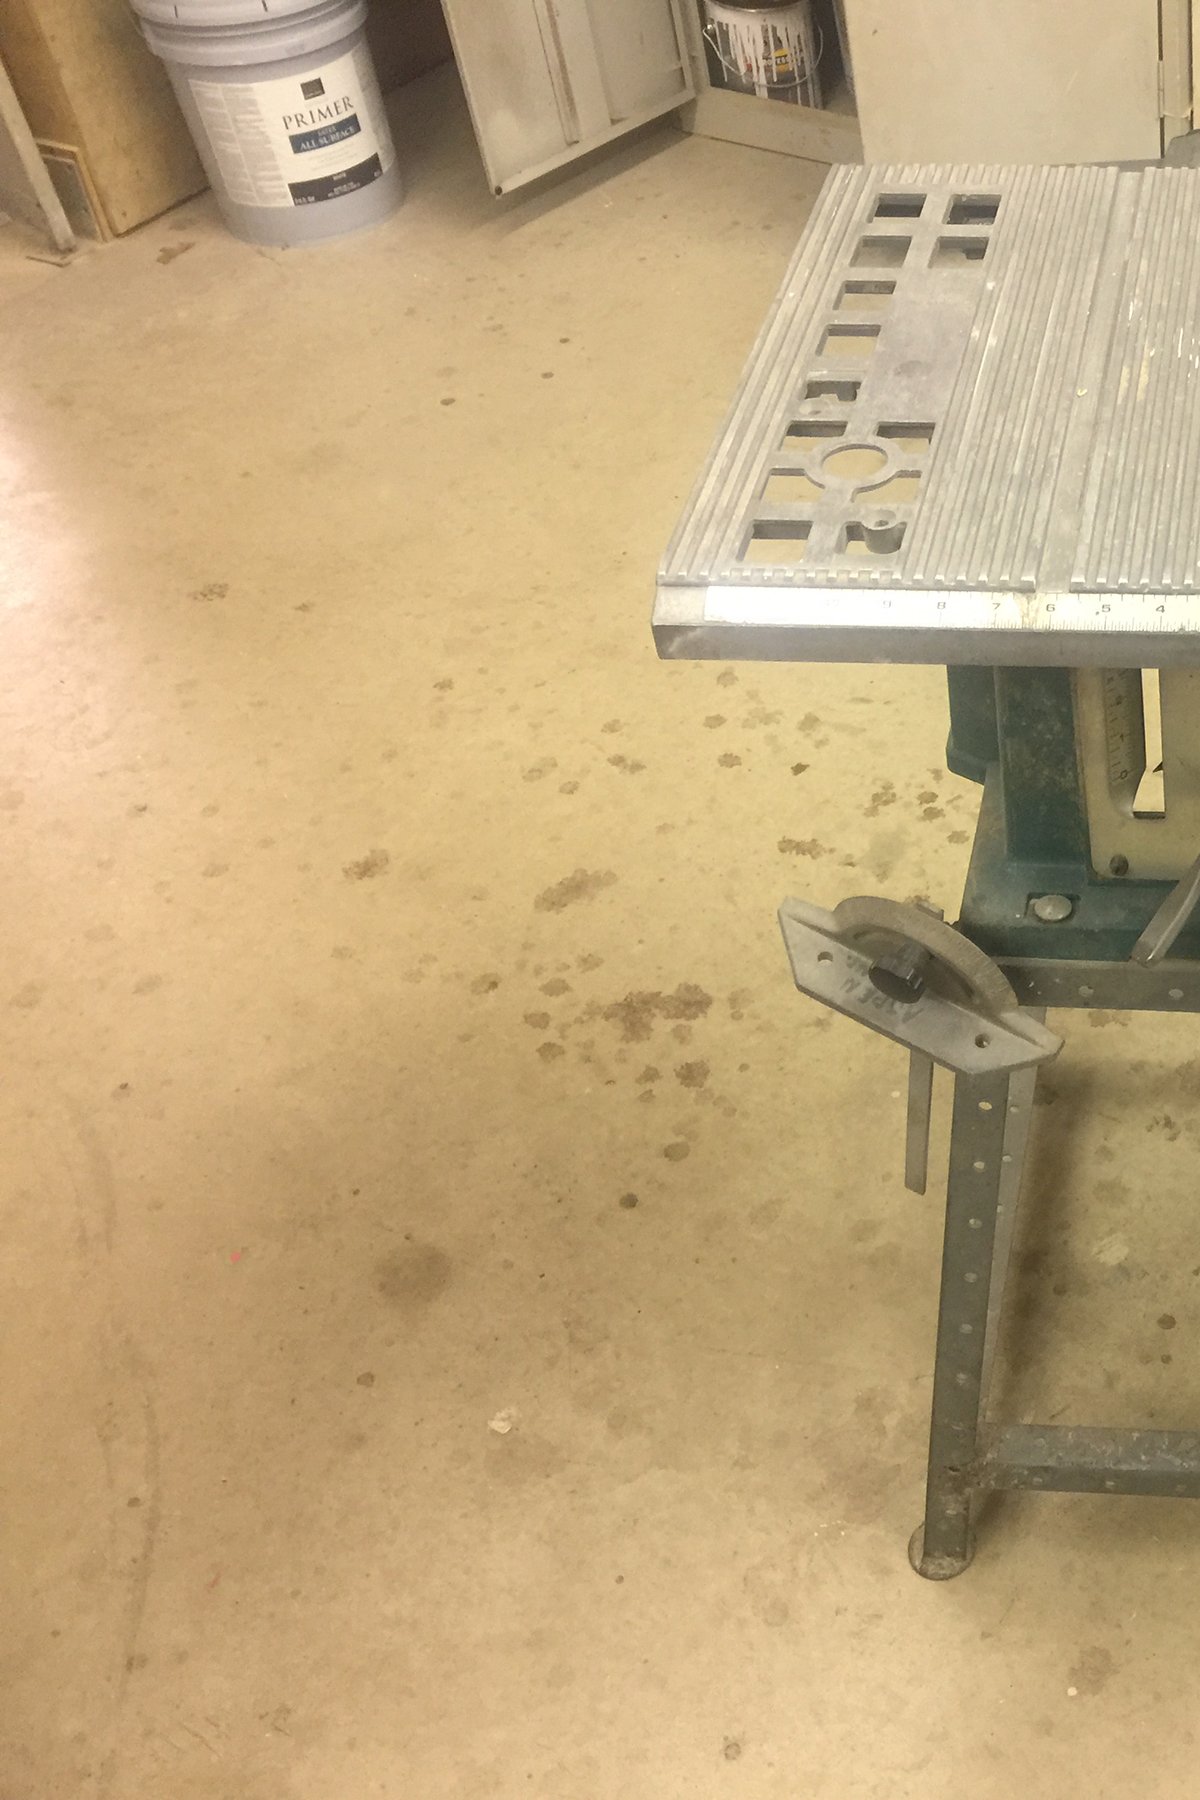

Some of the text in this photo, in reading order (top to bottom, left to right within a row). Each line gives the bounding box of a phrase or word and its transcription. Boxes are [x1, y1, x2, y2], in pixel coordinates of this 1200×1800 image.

[282, 96, 354, 130] PRIMER
[300, 140, 318, 151] ALL
[936, 601, 946, 610] 8
[992, 602, 1001, 611] 7
[1046, 603, 1056, 612] 6
[1101, 604, 1111, 613] 5
[1155, 604, 1166, 613] 4
